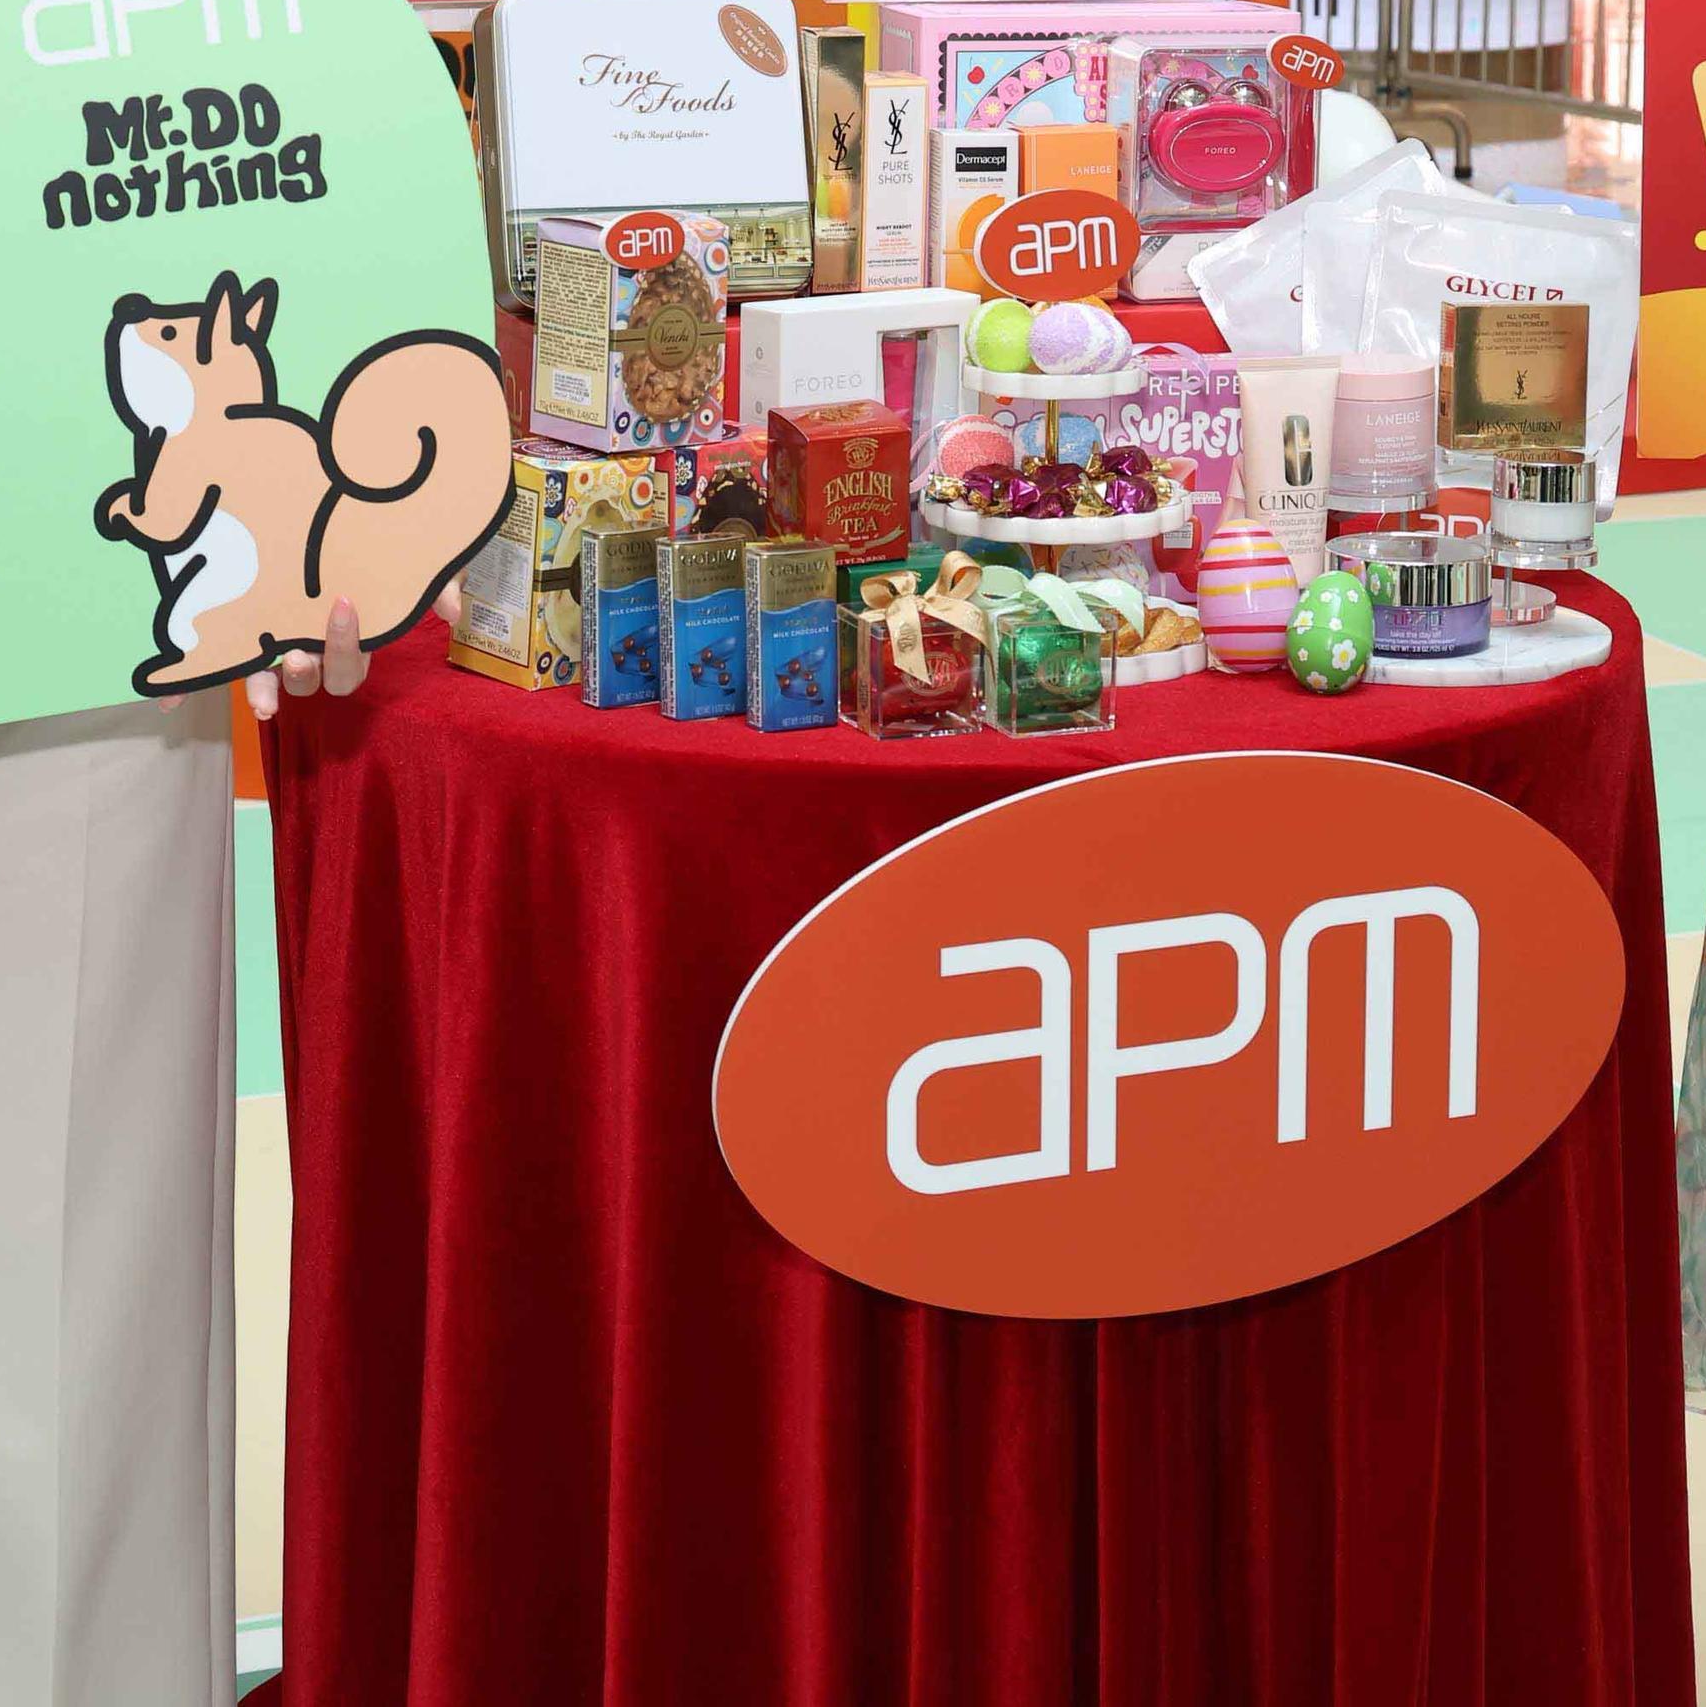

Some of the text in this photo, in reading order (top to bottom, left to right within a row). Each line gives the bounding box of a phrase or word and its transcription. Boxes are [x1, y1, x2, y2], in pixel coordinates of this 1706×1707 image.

[579, 53, 662, 85] Fine
[1281, 45, 1335, 83] apm
[610, 79, 738, 114] Foods
[648, 130, 674, 141] Royal
[675, 130, 704, 139] Garden
[956, 153, 1006, 166] Dermacept
[1204, 146, 1236, 155] FOREO
[882, 160, 909, 172] PURE
[1070, 165, 1113, 176] LANEIGE
[42, 133, 328, 230] nothing
[878, 173, 913, 185] SHOTS
[619, 226, 673, 258] apm
[1009, 215, 1118, 278] apm
[655, 324, 690, 343] Venchi
[794, 374, 863, 393] FOREO
[1366, 410, 1421, 426] LANEIGE
[1115, 403, 1243, 458] SUPERST
[823, 470, 894, 507] ENGLISH
[1259, 491, 1325, 511] CLINIQU
[827, 496, 897, 526] Breakfast
[841, 516, 878, 534] TEA
[607, 541, 658, 558] GODIV
[767, 560, 830, 576] GODIVA
[626, 605, 659, 613] CHOCOLAT
[703, 615, 741, 625] CHOCOLATE
[791, 626, 830, 637] CHOCOLATE
[886, 885, 1480, 1195] apm
